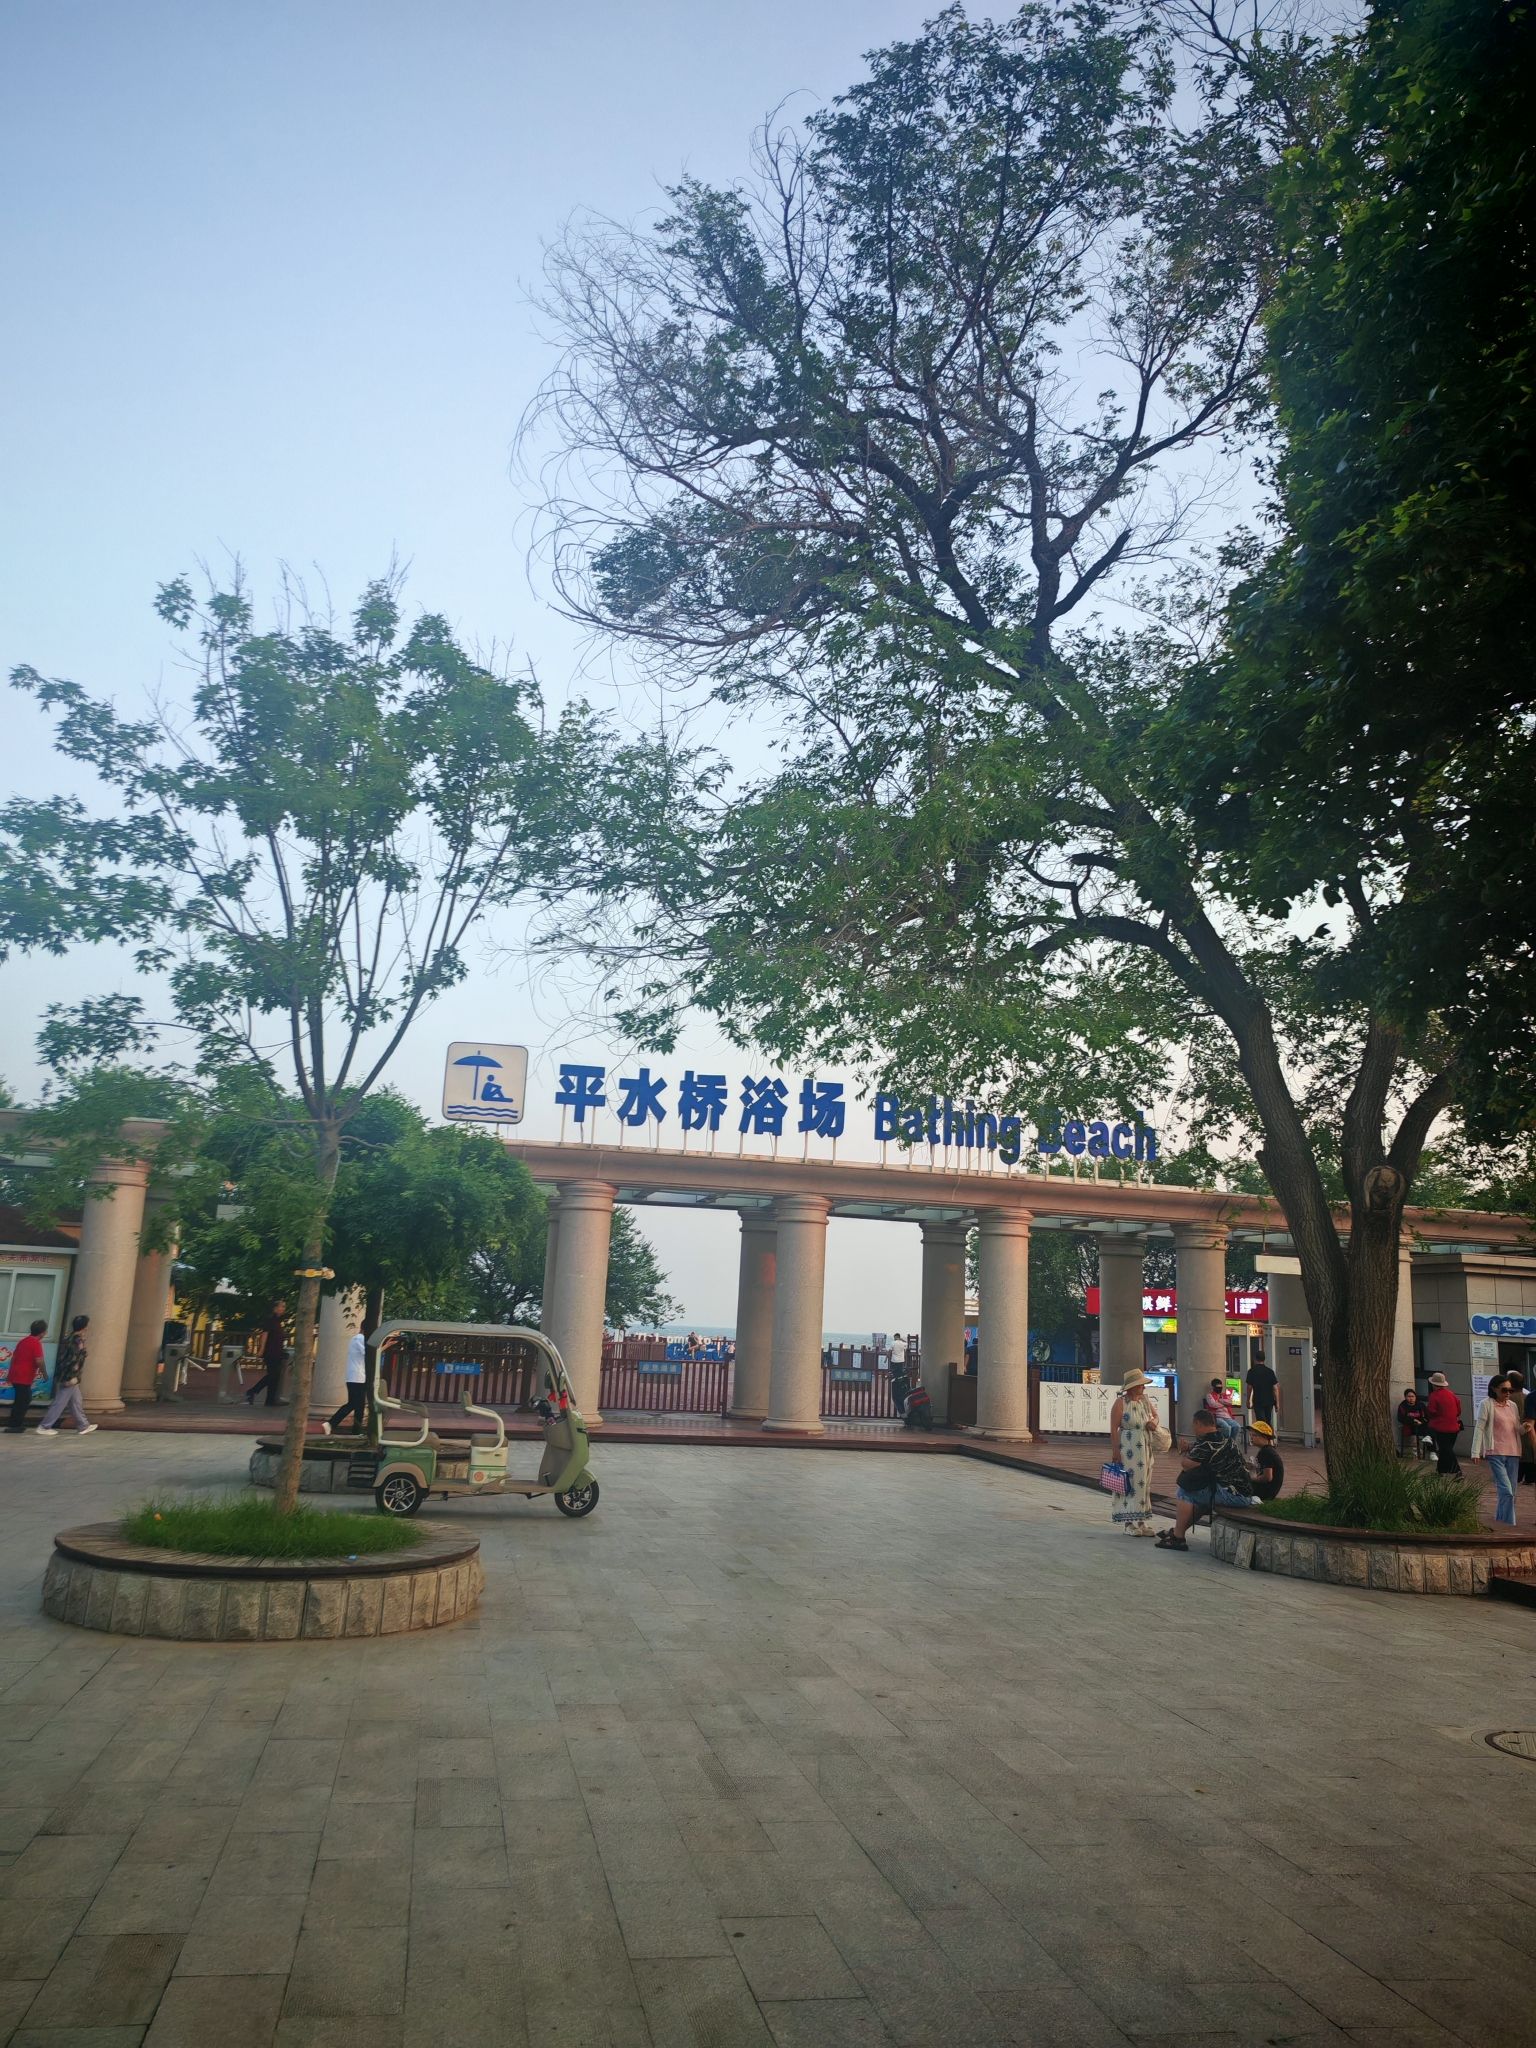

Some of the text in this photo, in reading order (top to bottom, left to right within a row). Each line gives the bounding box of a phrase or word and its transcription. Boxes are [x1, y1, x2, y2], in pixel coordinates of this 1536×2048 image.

[555, 1063, 846, 1138] 平水桥浴场
[874, 1092, 1022, 1165] Bathing
